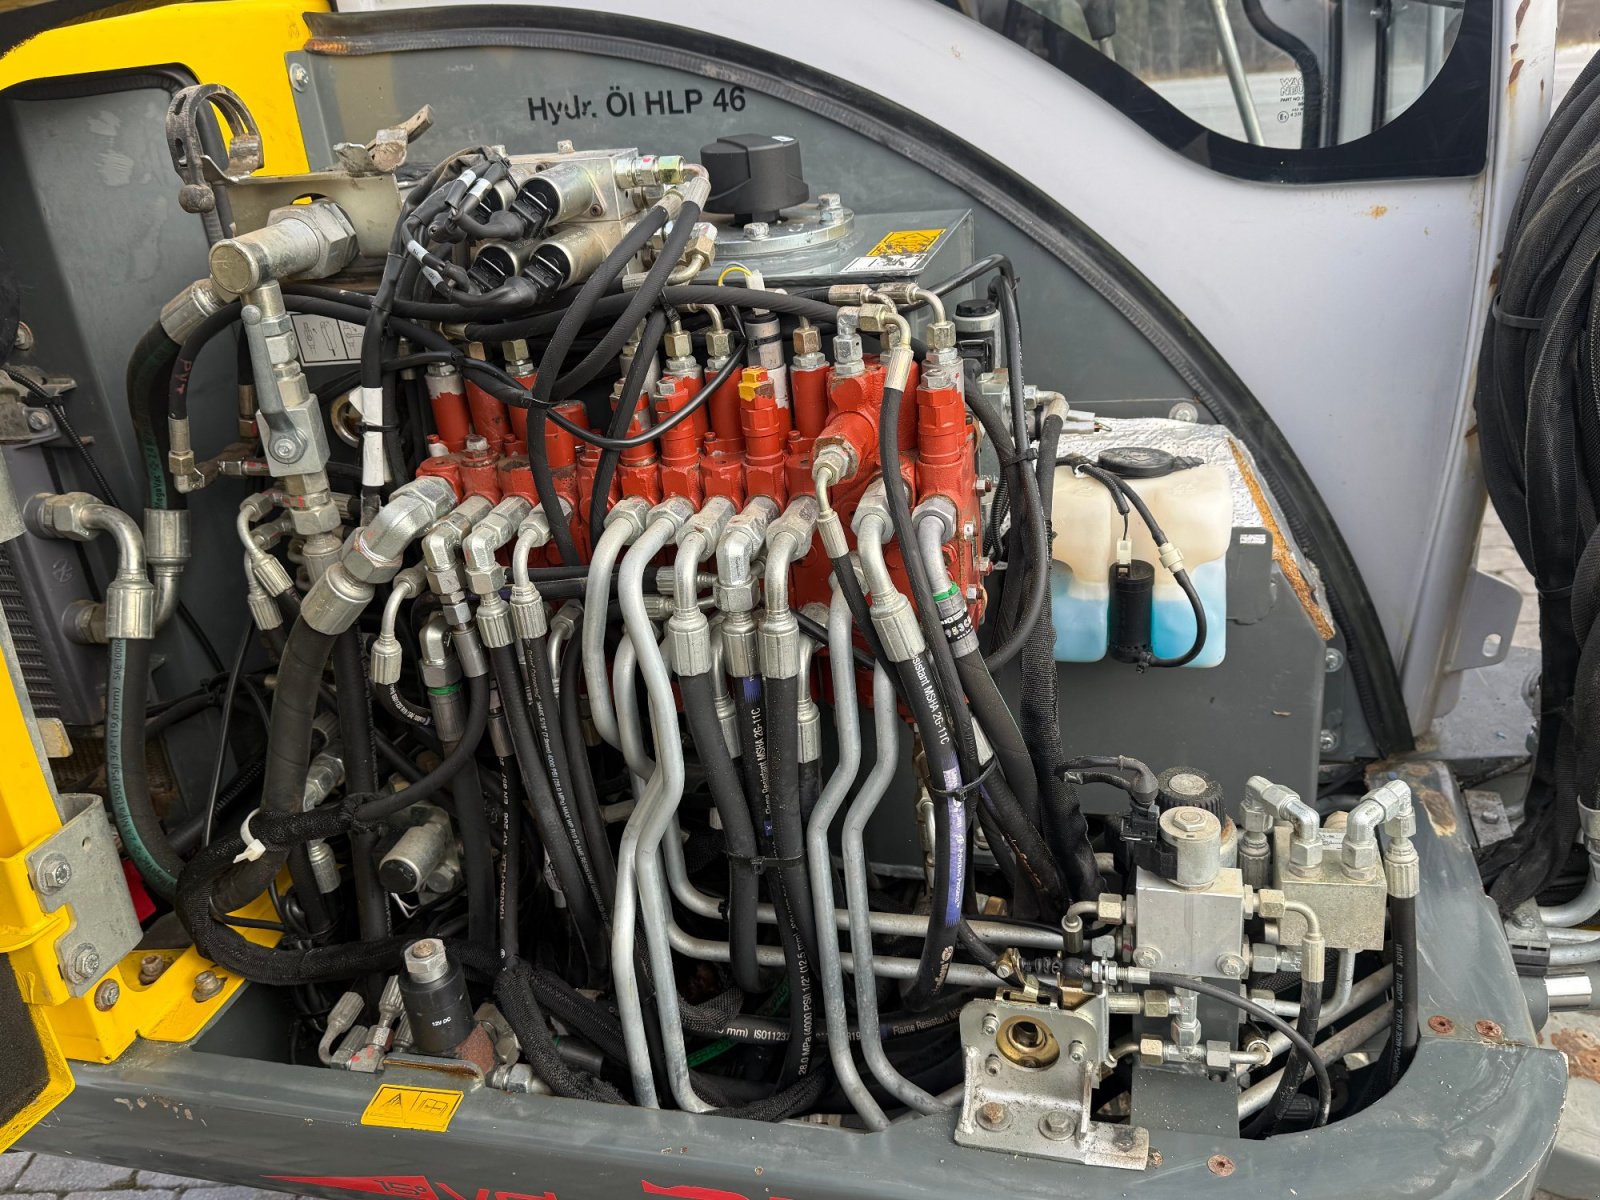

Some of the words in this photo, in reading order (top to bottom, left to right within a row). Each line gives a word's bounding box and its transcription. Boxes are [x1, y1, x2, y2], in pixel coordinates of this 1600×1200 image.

[527, 95, 597, 126] Hydr.
[606, 86, 635, 118] Öl
[645, 89, 703, 116] HLP
[713, 87, 746, 113] 46
[113, 666, 122, 681] SAE
[110, 688, 121, 713] mm)
[913, 655, 930, 687] esistant
[924, 685, 940, 713] MSHA
[932, 711, 950, 745] 2G-11C
[751, 707, 763, 738] 2G-11C
[755, 738, 766, 762] MSHA
[727, 1027, 749, 1039] mm)
[802, 1035, 812, 1056] MPa
